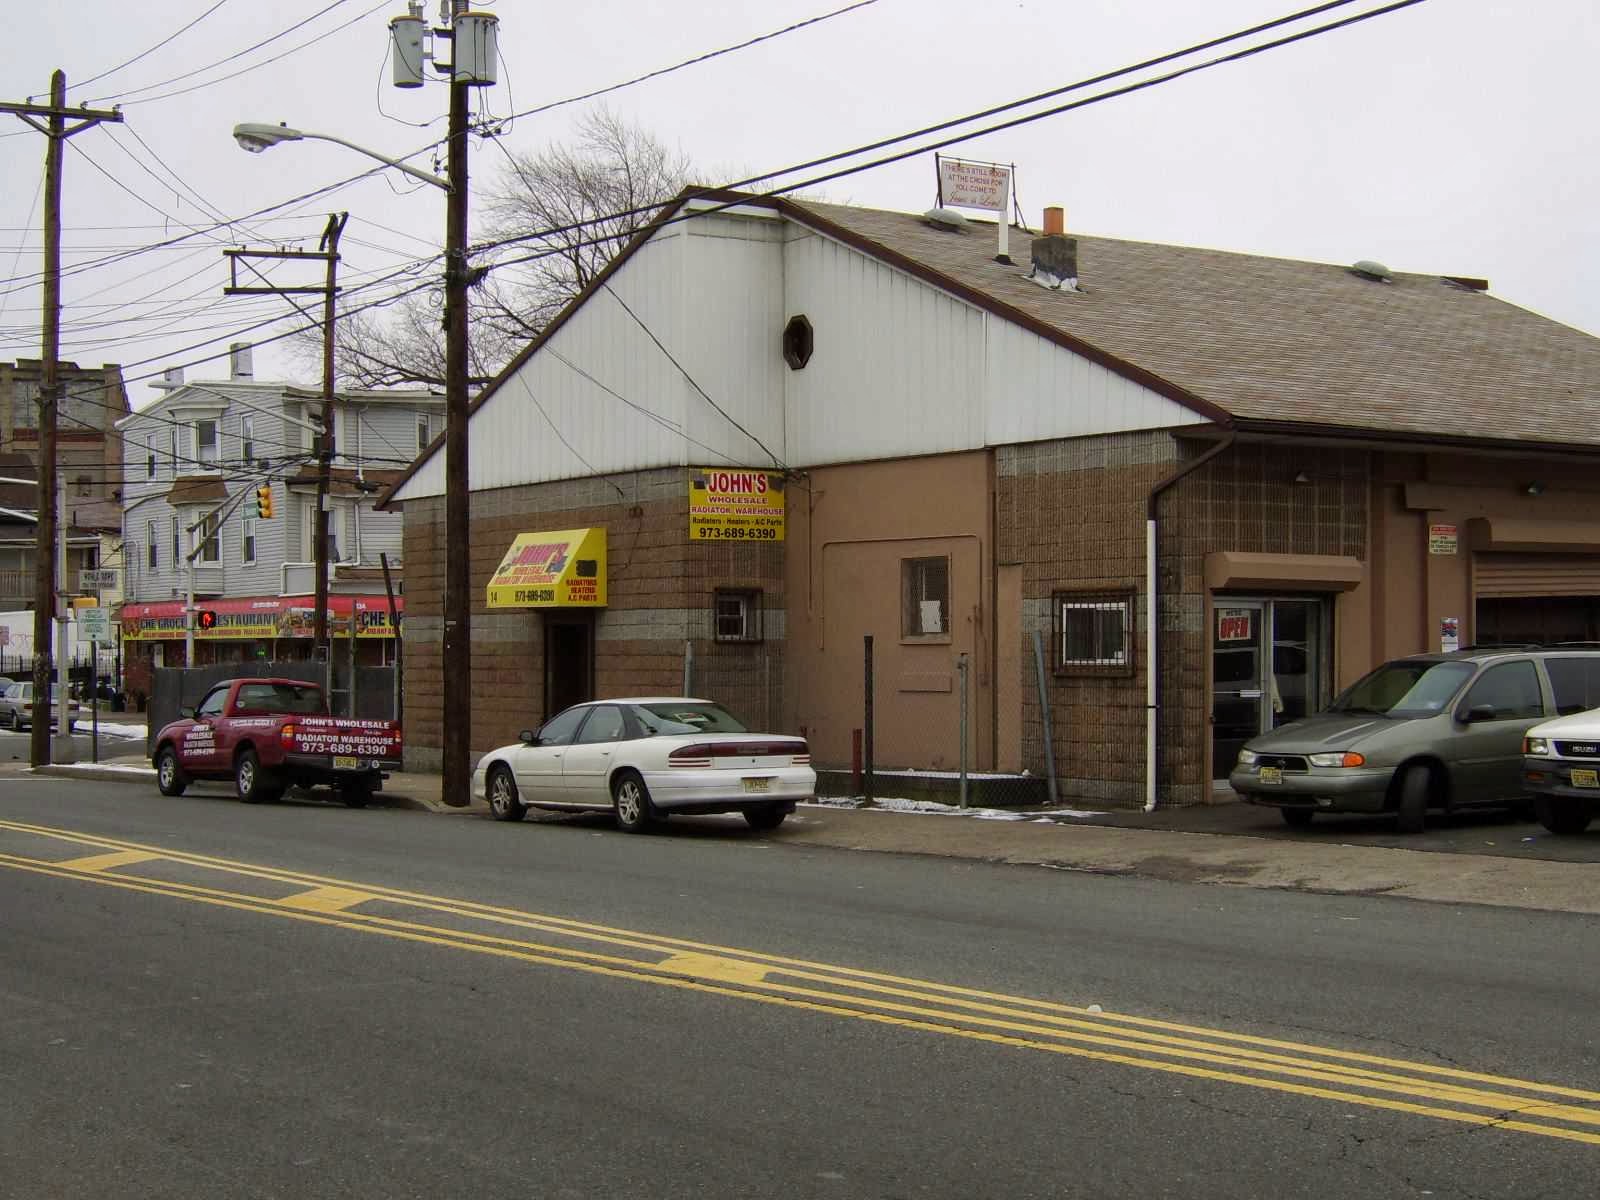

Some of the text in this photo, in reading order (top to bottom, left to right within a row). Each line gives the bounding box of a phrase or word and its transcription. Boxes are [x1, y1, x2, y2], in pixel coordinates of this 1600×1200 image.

[971, 168, 987, 176] STILL
[989, 169, 1007, 178] ROOM
[958, 175, 968, 183] THE
[969, 176, 990, 184] CROSS
[955, 184, 968, 192] YOU
[969, 185, 987, 193] COME
[707, 472, 768, 494] JOHN'S
[708, 495, 769, 505] WHOLESALE
[691, 505, 784, 516] RADIATOR WAREHOUSE
[693, 517, 721, 525] Radiators
[727, 517, 751, 526] Heaters
[766, 518, 783, 526] Parts
[699, 527, 776, 539] 973-689-6390
[566, 578, 598, 587] RADIATORS
[490, 591, 498, 603] 14
[578, 594, 598, 602] PARTS
[1221, 616, 1249, 638] OPEN
[300, 717, 334, 727] JOHN'S
[335, 719, 390, 730] WHOLESALE
[295, 733, 394, 745] RADIATOR WAREHOUSE
[302, 742, 387, 755] 973-689-6390
[1572, 745, 1597, 753] ISUZU
